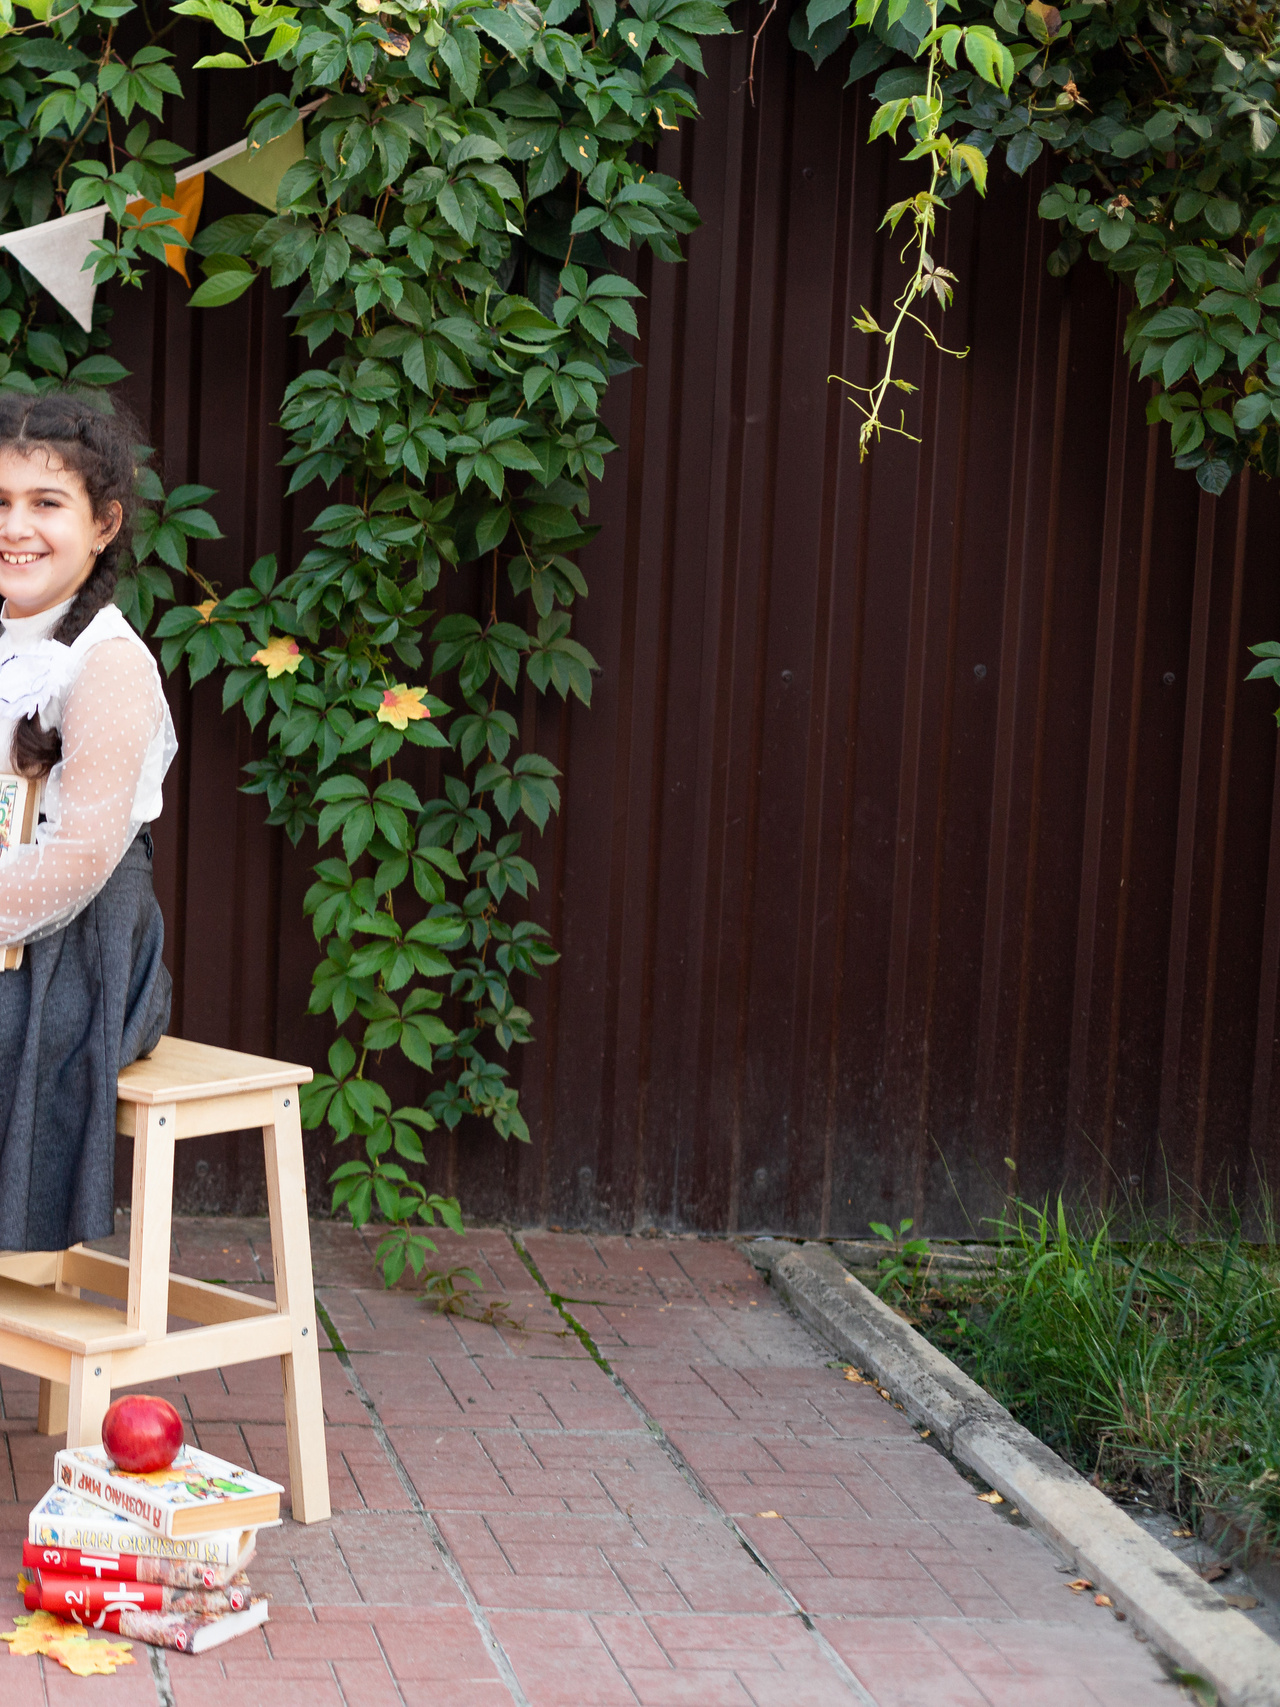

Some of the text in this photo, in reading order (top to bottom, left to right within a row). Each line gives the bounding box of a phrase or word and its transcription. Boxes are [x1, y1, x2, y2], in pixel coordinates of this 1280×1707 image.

[77, 1472, 162, 1528] Я ПОЗНАЮ МИР
[70, 1529, 113, 1549] МИР
[119, 1534, 200, 1559] ПОЗНАЮ
[43, 1550, 62, 1565] 3
[205, 1547, 220, 1563] Я
[64, 1589, 84, 1606] 2
